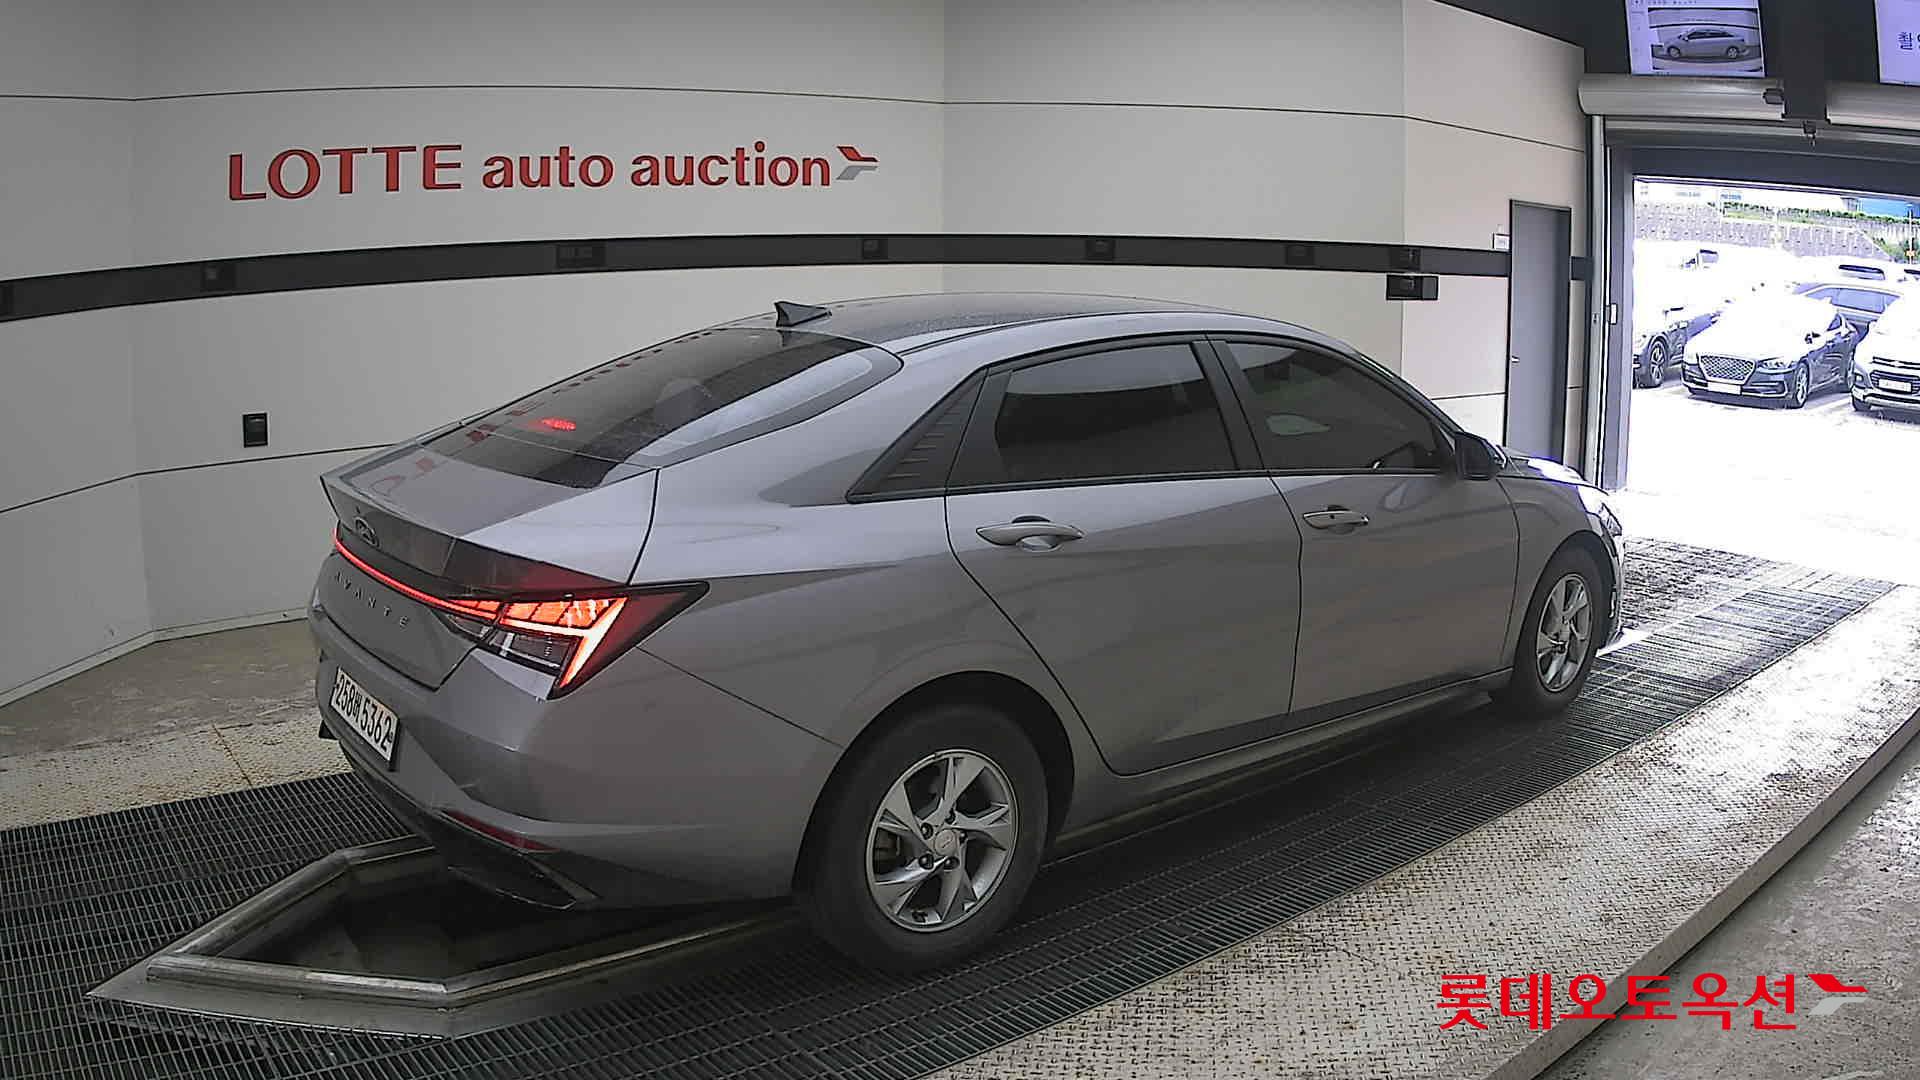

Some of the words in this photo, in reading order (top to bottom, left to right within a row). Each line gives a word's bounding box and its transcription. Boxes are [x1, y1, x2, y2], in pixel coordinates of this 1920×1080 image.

[228, 144, 463, 201] LOTTE
[482, 146, 615, 189] auto
[630, 141, 832, 187] auction
